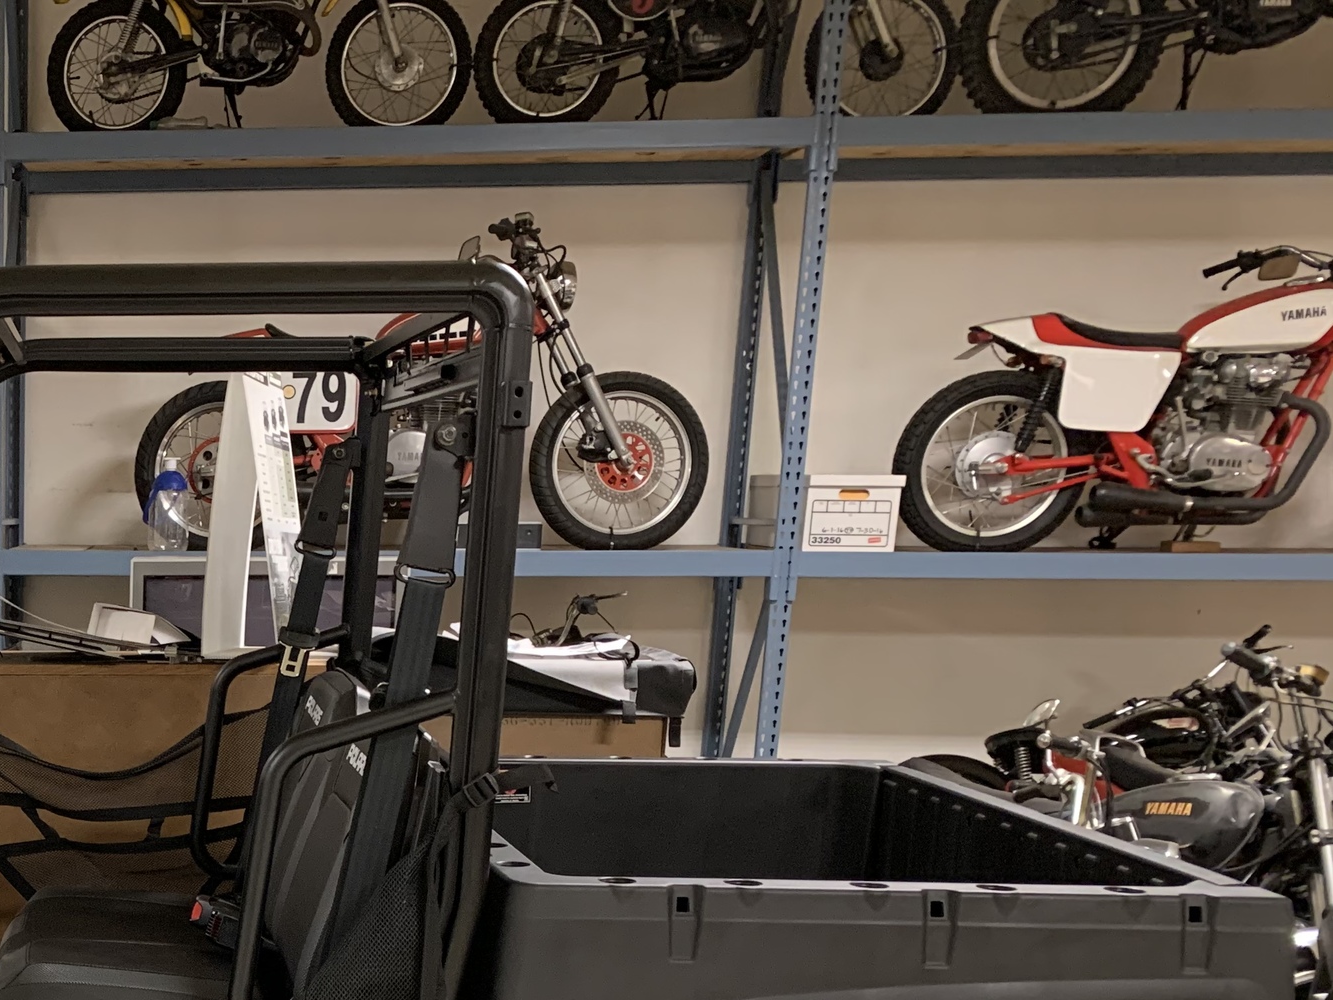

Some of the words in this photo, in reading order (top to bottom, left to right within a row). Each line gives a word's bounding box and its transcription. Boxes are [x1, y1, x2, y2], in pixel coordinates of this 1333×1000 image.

[1280, 305, 1328, 322] YAMAHA
[292, 371, 347, 424] 79
[396, 452, 422, 461] YAMA
[1206, 457, 1242, 468] YAMAHA
[811, 536, 842, 544] 33250
[345, 742, 368, 778] POLAR
[1144, 802, 1193, 816] YAMAHA
